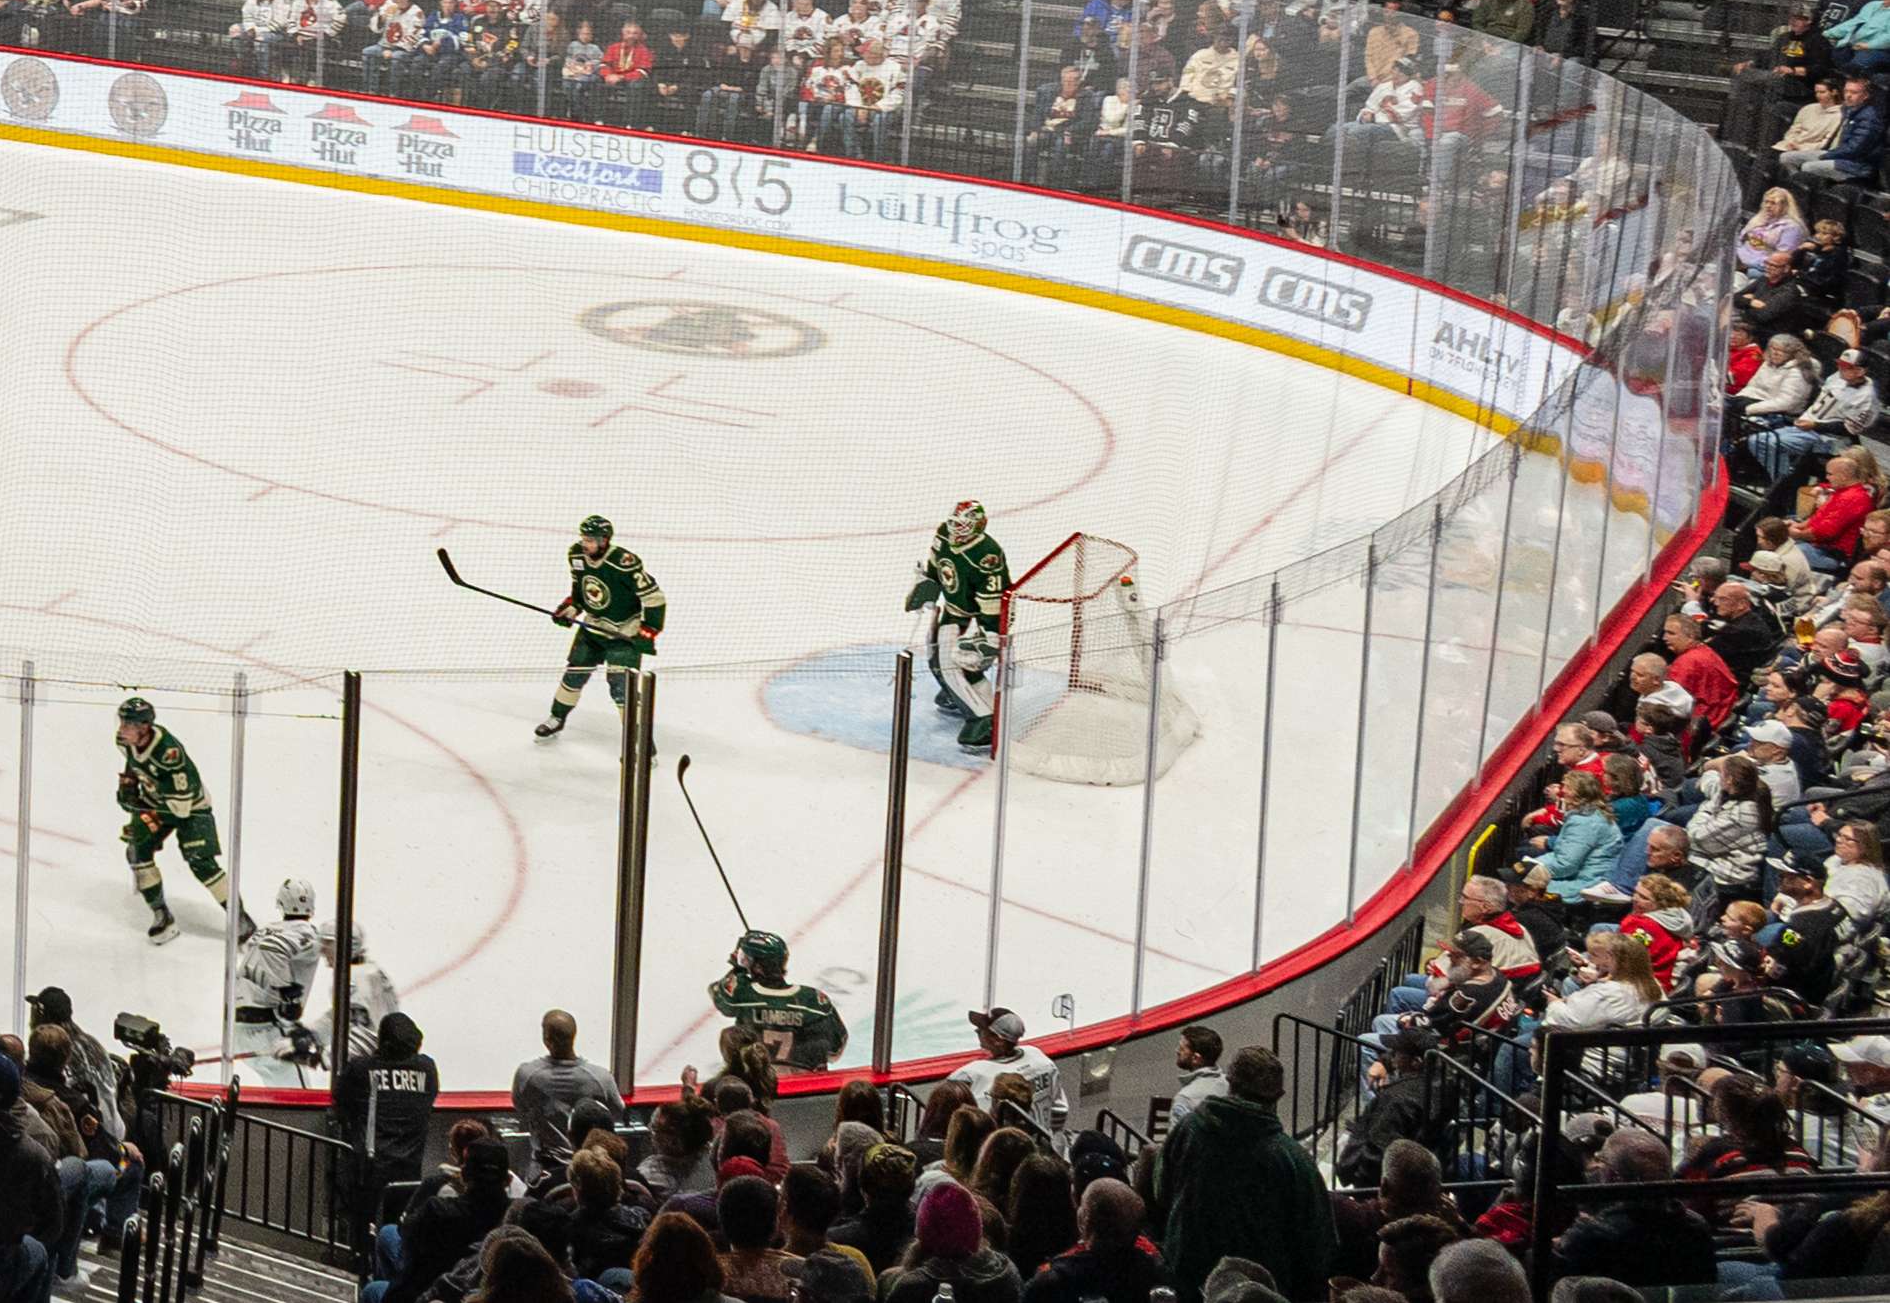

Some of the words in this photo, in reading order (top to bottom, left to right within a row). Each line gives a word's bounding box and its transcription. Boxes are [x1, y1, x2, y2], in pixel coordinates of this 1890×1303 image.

[227, 110, 282, 135] Pizza
[311, 121, 367, 147] Pizza
[228, 129, 273, 153] Hut
[312, 141, 357, 165] Hut
[396, 133, 454, 160] Pizza
[512, 124, 665, 169] HULSEBUS
[397, 152, 445, 178] Hut
[533, 155, 642, 186] Rockford
[511, 176, 662, 213] CHIROPRACTIC
[971, 238, 1026, 262] spas
[1129, 242, 1238, 293] cms
[1264, 272, 1368, 329] cms
[752, 1008, 803, 1028] LAMBOS
[763, 1029, 795, 1062] 7
[368, 1070, 390, 1090] ICE
[392, 1071, 426, 1092] CREW
